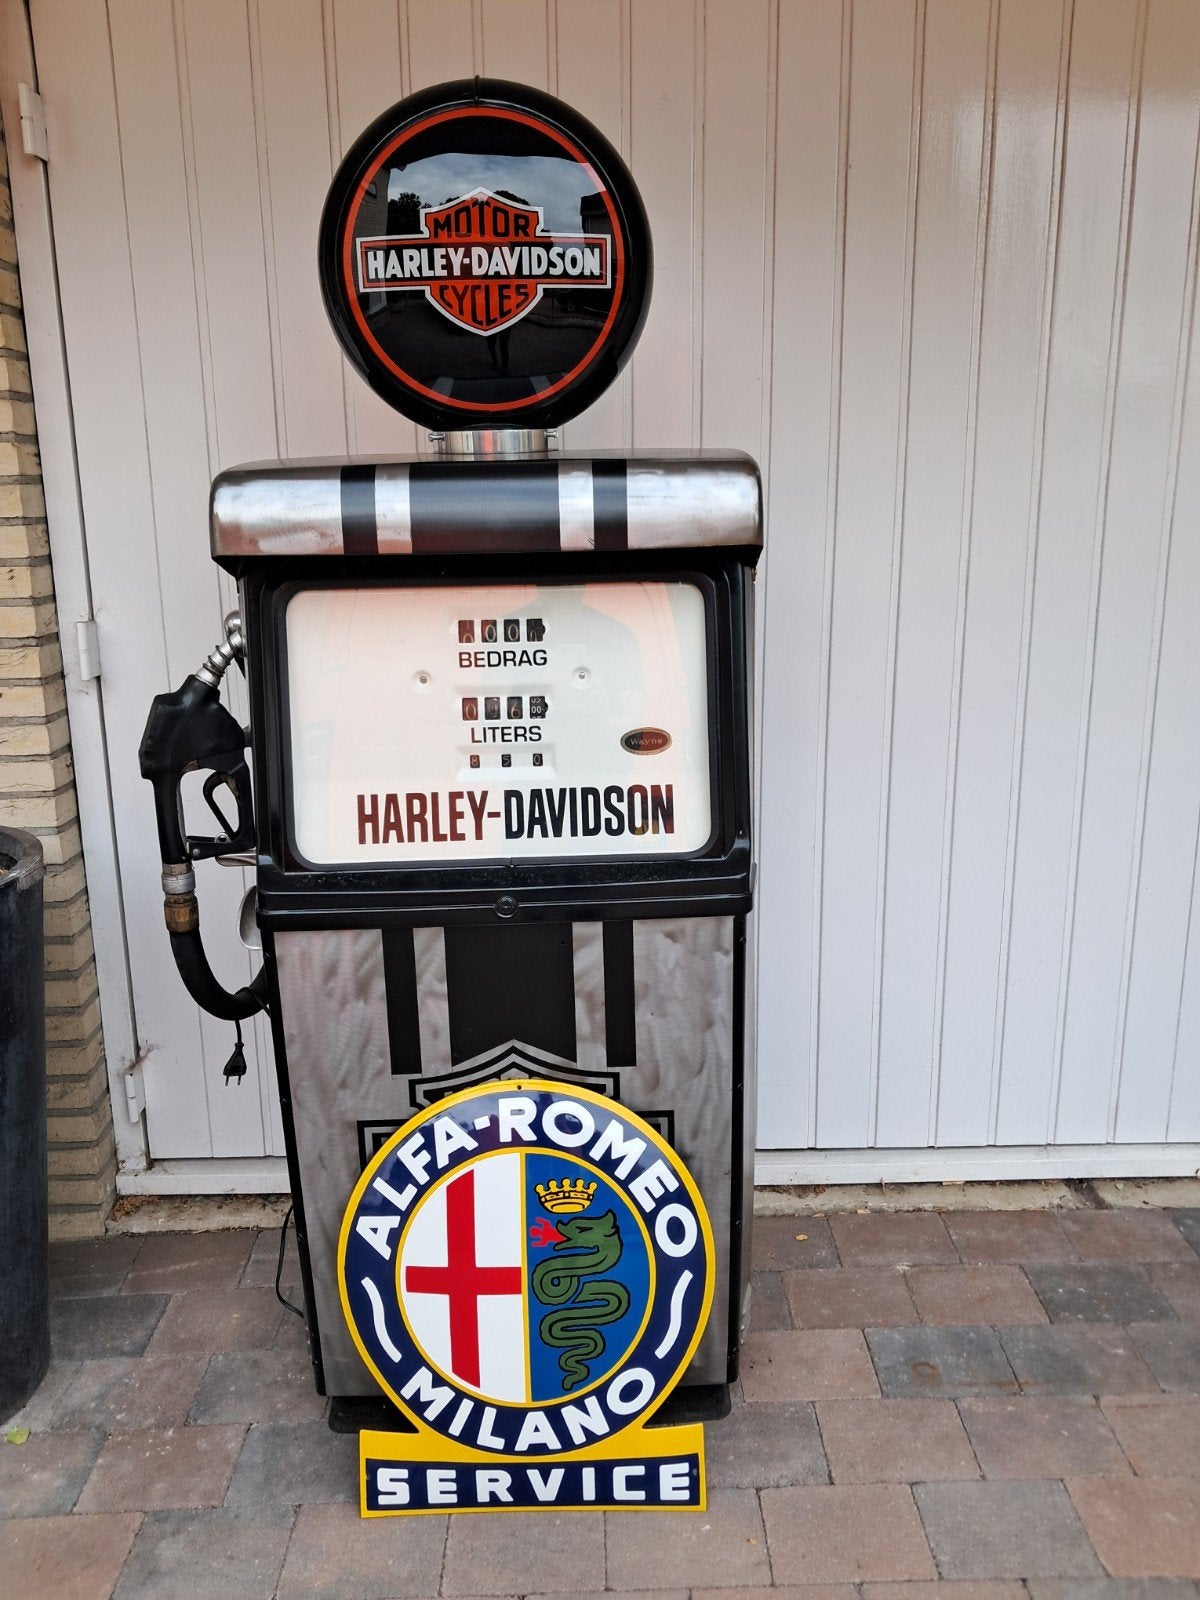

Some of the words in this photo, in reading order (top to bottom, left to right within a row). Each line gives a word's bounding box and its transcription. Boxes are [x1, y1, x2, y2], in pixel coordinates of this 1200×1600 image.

[433, 200, 530, 238] MOTOR
[367, 246, 600, 279] HARLEY-DAVIDSON
[439, 284, 529, 325] CYCLES
[458, 649, 548, 668] BEDRAG
[471, 726, 542, 743] LITERS
[630, 738, 663, 746] Wayne
[356, 783, 675, 844] HARLEY-DAVIDSON
[400, 1366, 656, 1452] MILANO
[376, 1462, 691, 1505] SERVICE
